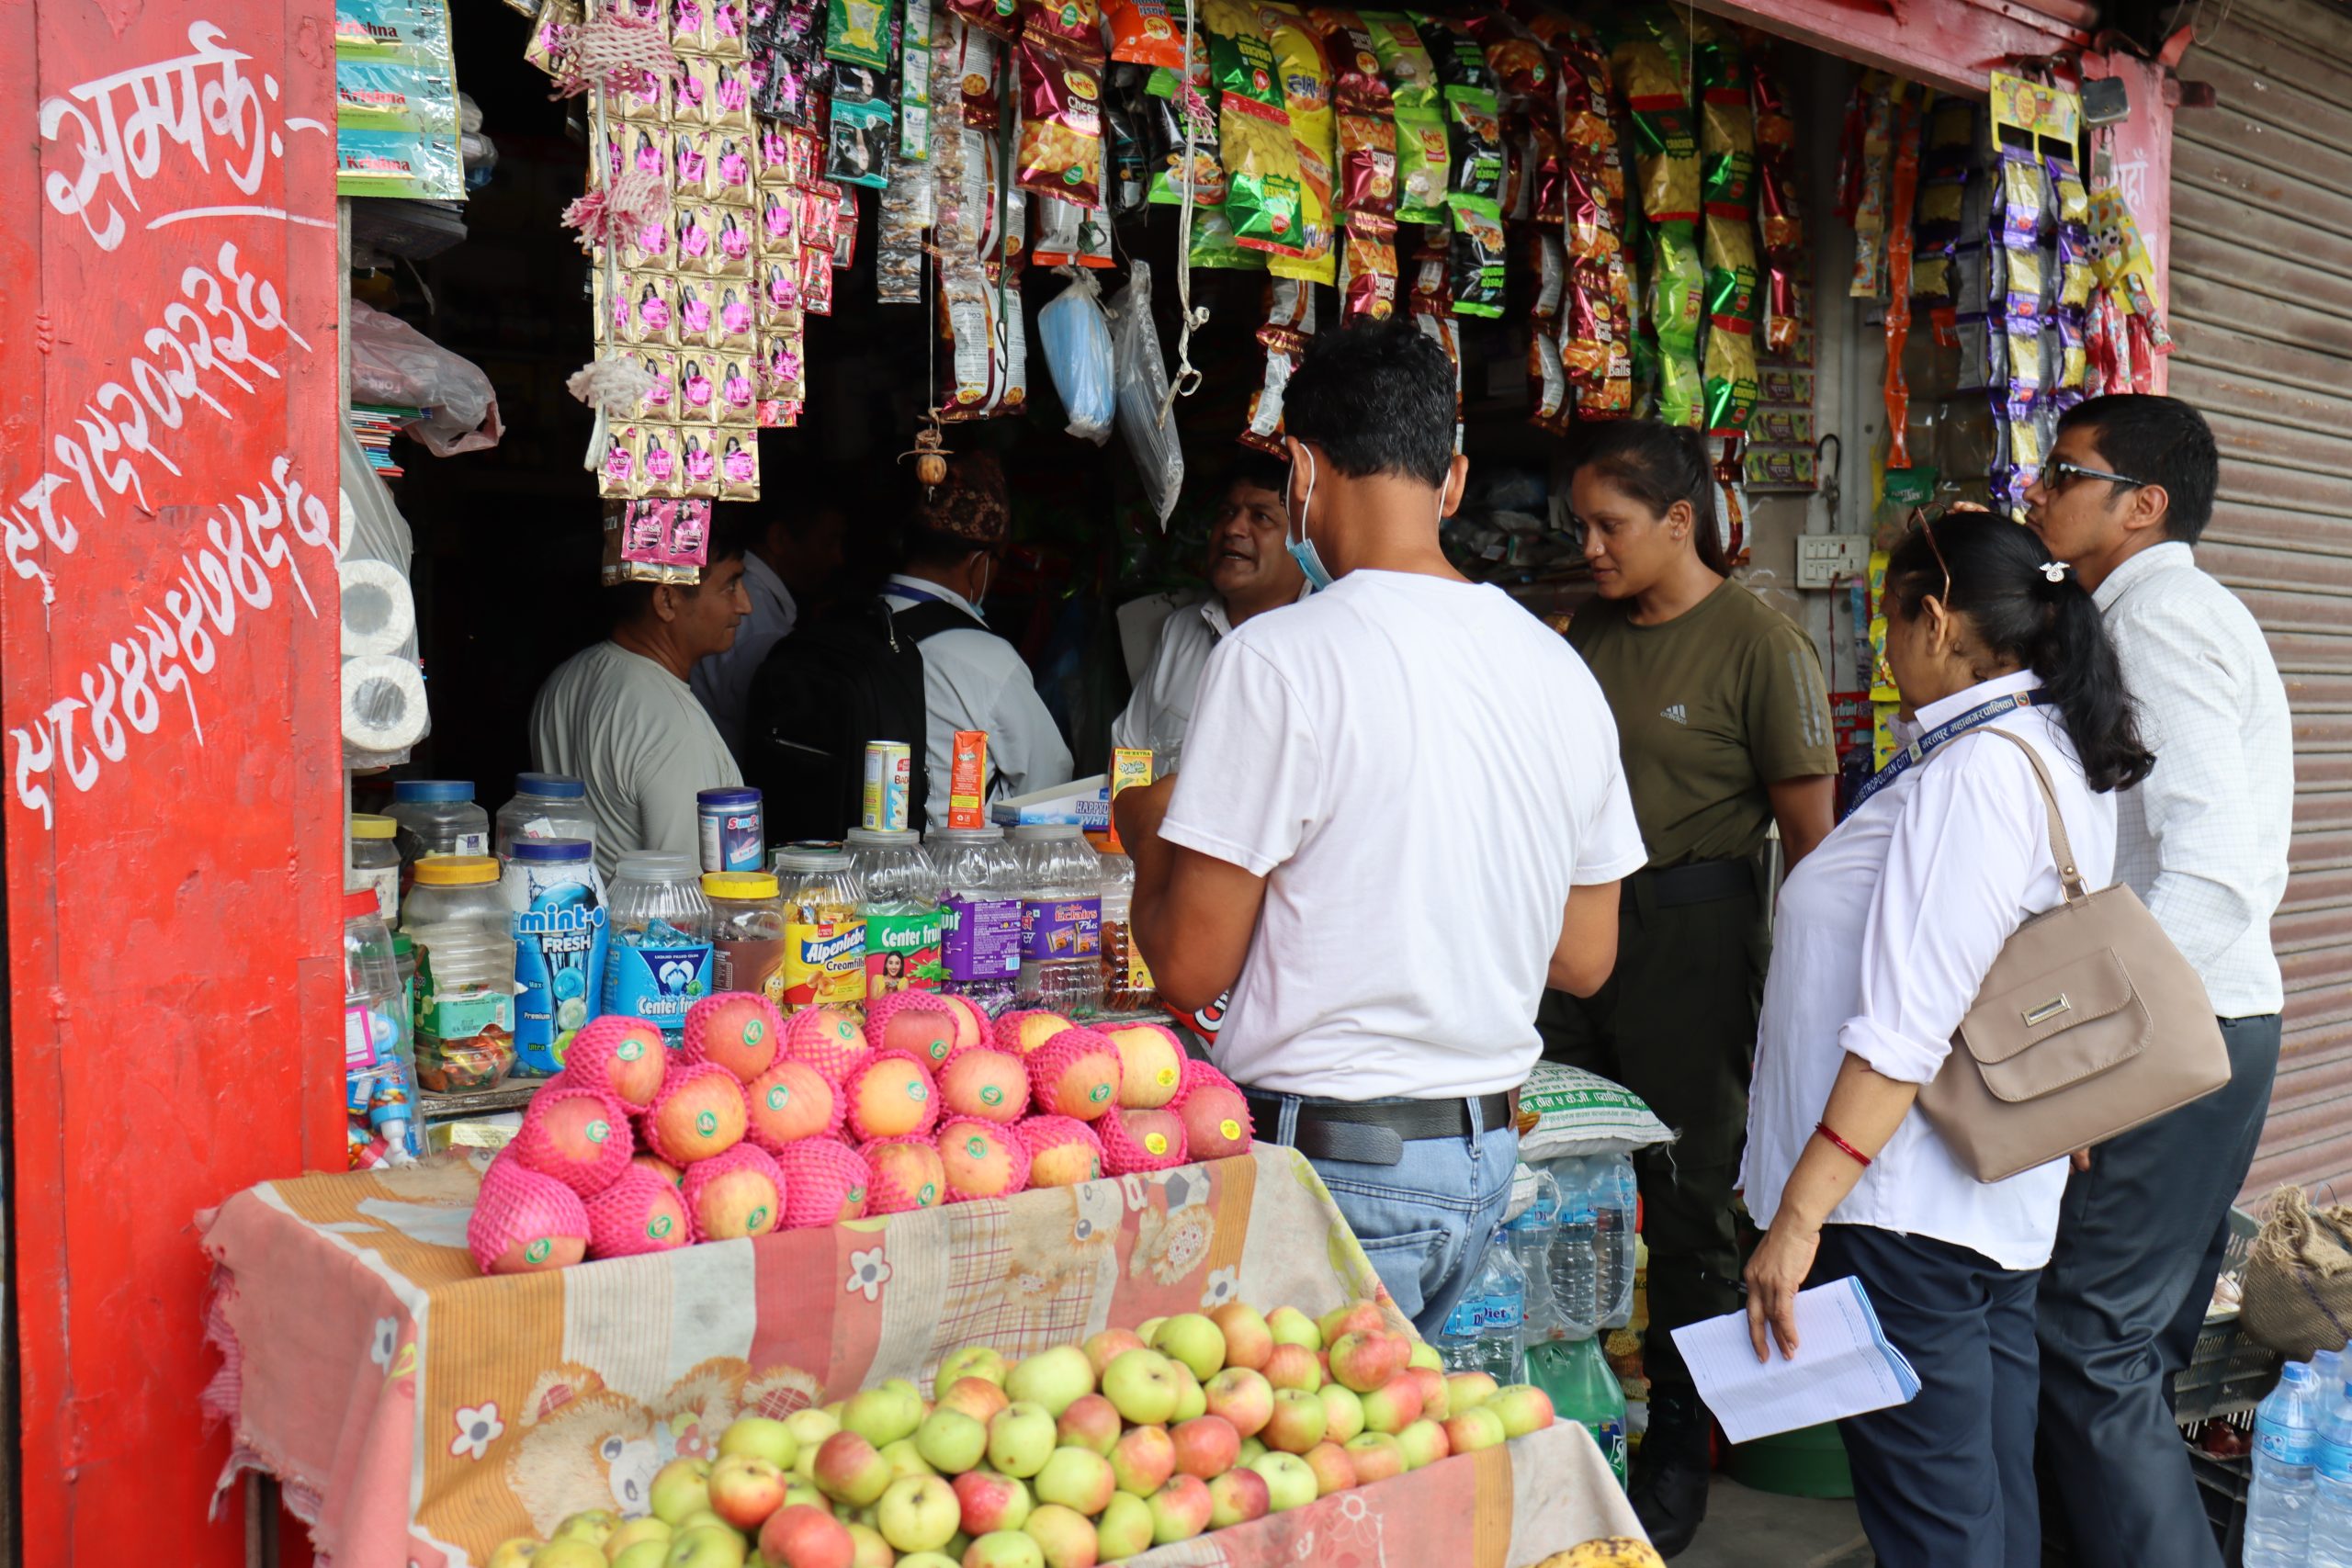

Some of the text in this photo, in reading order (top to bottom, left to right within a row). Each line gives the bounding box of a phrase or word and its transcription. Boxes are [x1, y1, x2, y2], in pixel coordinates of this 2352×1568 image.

[346, 154, 412, 172] Krishna
[1896, 750, 1910, 770] CITY
[542, 934, 593, 954] FRESH
[806, 928, 866, 964] Alpenliebe
[881, 926, 921, 948] Center
[825, 958, 865, 972] Creamfills
[638, 996, 677, 1015] Center
[524, 1011, 552, 1021] Premium
